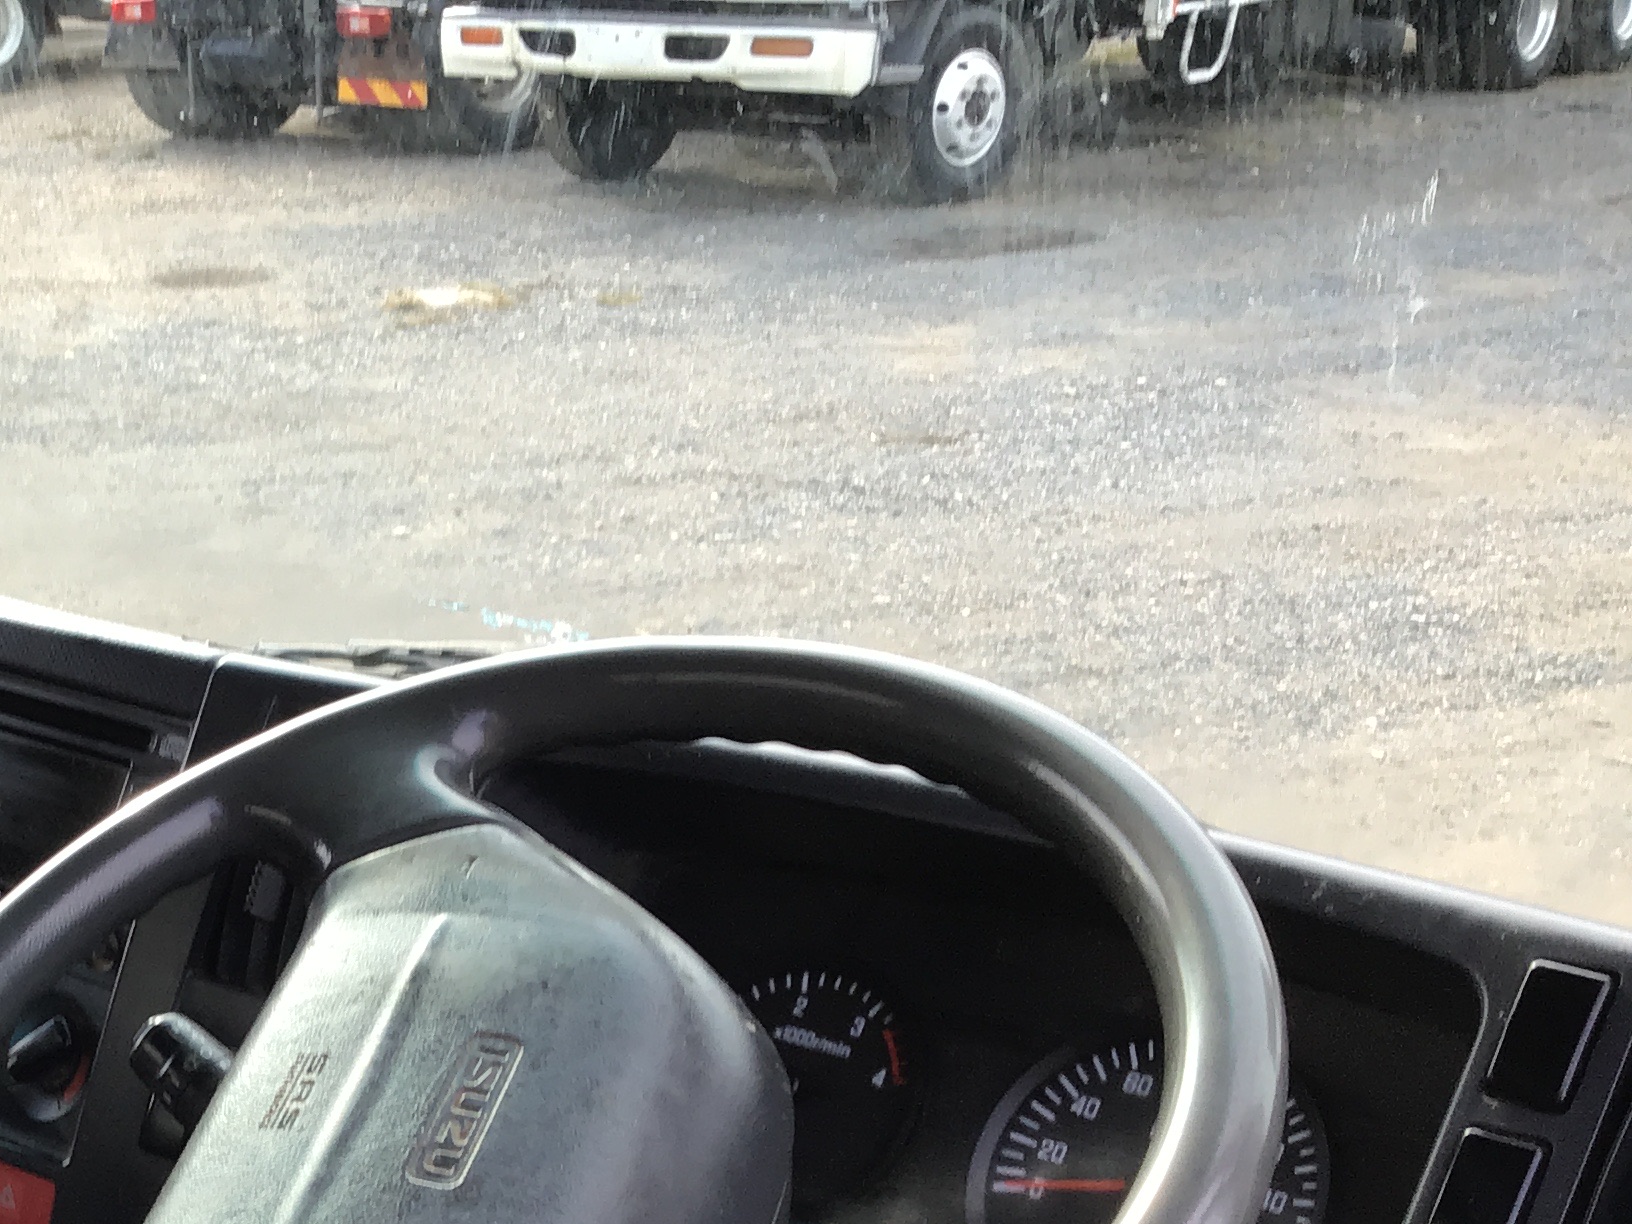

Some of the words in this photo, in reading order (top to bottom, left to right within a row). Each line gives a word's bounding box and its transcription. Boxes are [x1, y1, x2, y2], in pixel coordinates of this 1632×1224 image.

[871, 1067, 887, 1089] 4
[277, 1053, 329, 1131] SRS
[422, 1045, 509, 1177] ISUZU
[1070, 1095, 1101, 1121] 40
[1037, 1138, 1068, 1165] 20
